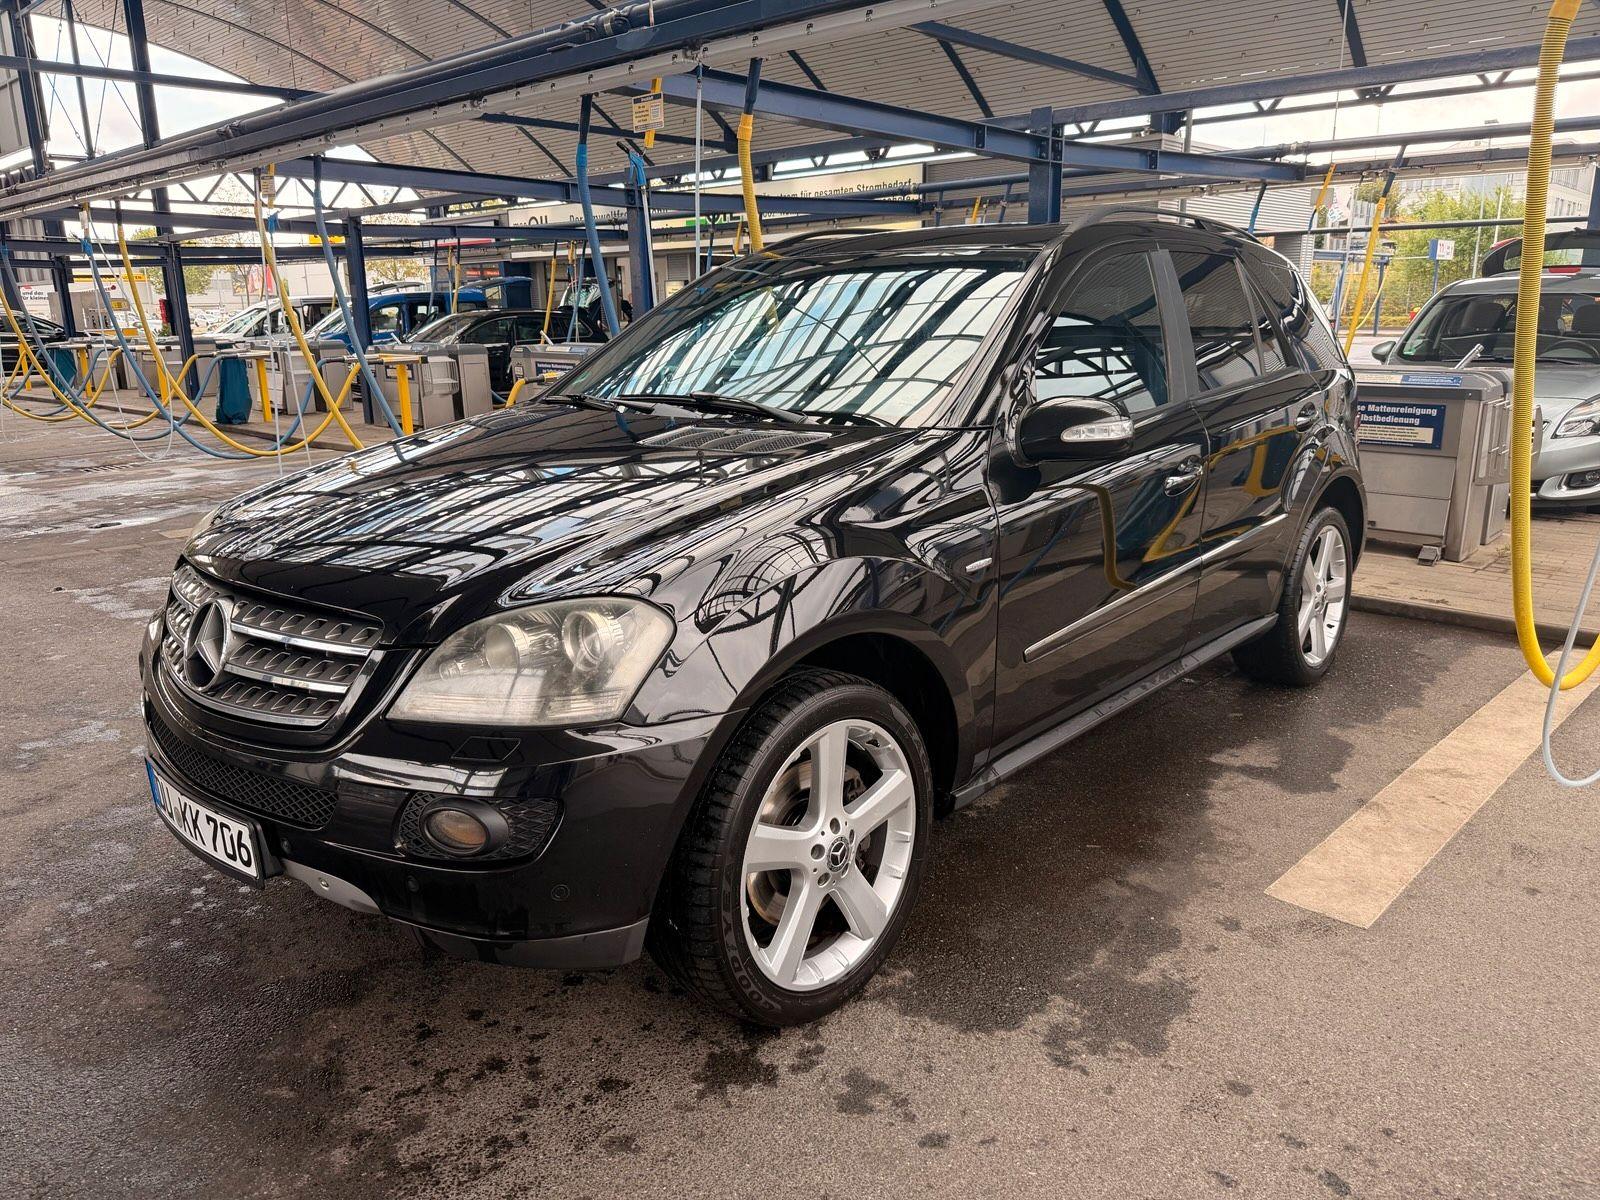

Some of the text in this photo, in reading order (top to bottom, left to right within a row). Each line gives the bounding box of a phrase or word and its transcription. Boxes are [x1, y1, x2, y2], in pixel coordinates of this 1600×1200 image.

[1367, 405, 1438, 416] Mattenreinigung
[1360, 414, 1420, 425] lbstbedienung
[178, 797, 206, 847] KK
[205, 814, 253, 868] 706
